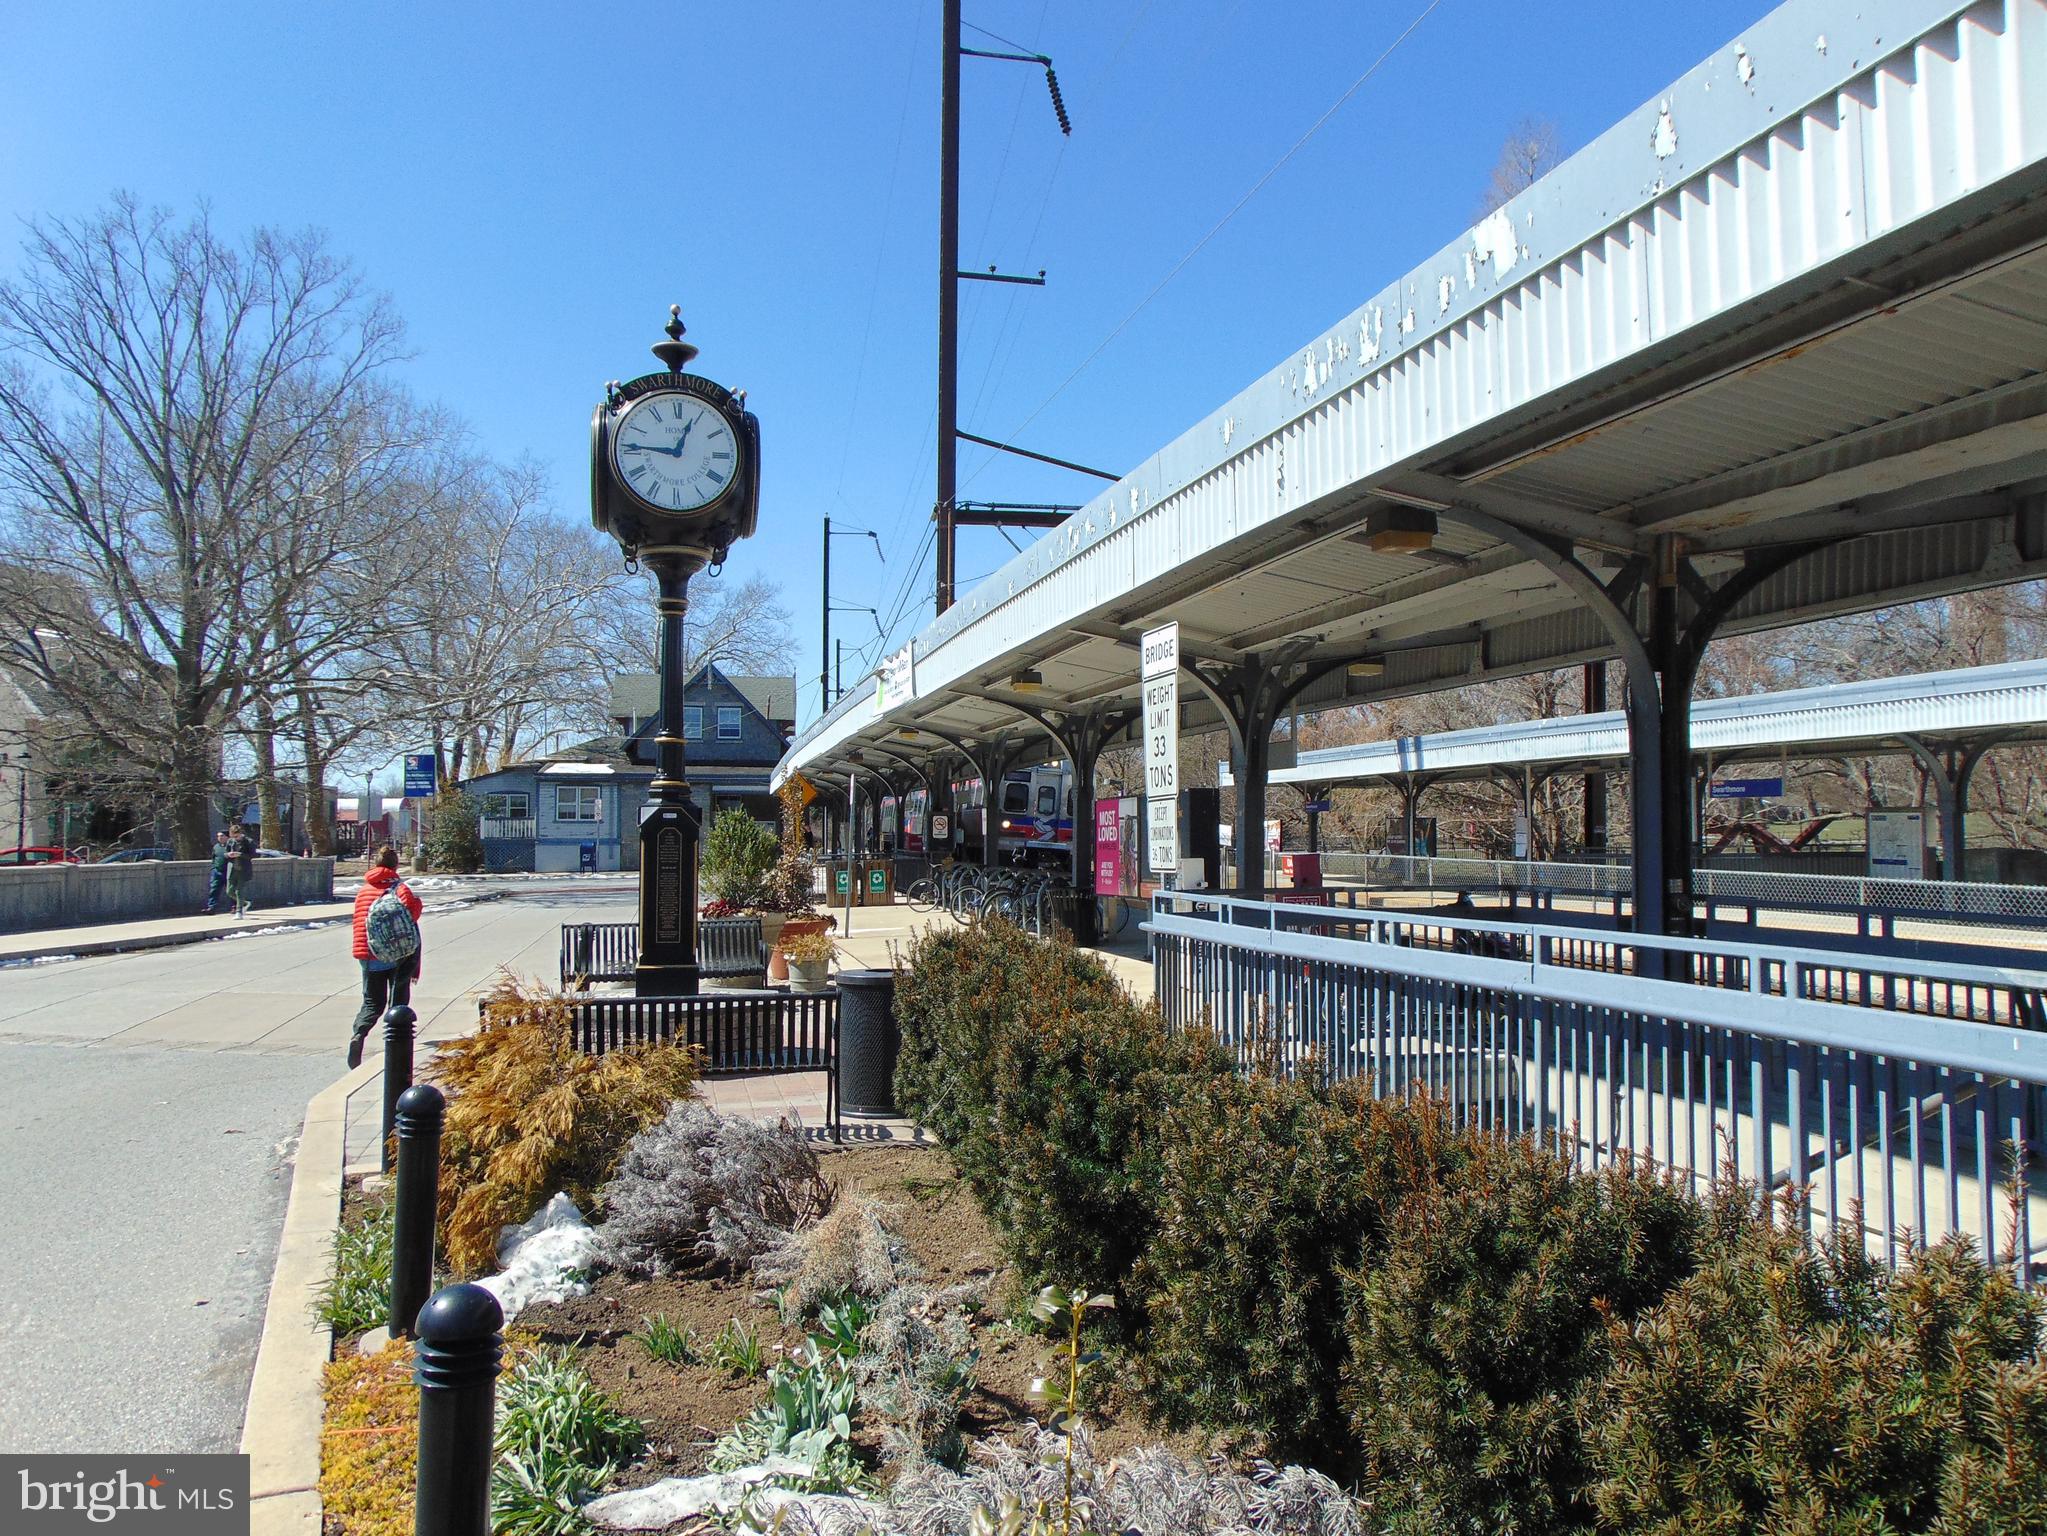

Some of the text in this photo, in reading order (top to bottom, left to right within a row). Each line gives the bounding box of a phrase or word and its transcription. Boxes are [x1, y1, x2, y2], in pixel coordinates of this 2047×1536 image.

[631, 373, 721, 398] SWARTHMORE
[1145, 638, 1174, 665] BRIDGE
[1146, 683, 1174, 707] WEIGHT
[1150, 708, 1170, 730] LIMIT
[1153, 735, 1166, 757] 33
[1149, 764, 1173, 788] TONS
[1099, 810, 1116, 826] MOST
[1098, 826, 1118, 842] LOVED
[1159, 846, 1173, 863] TONS
